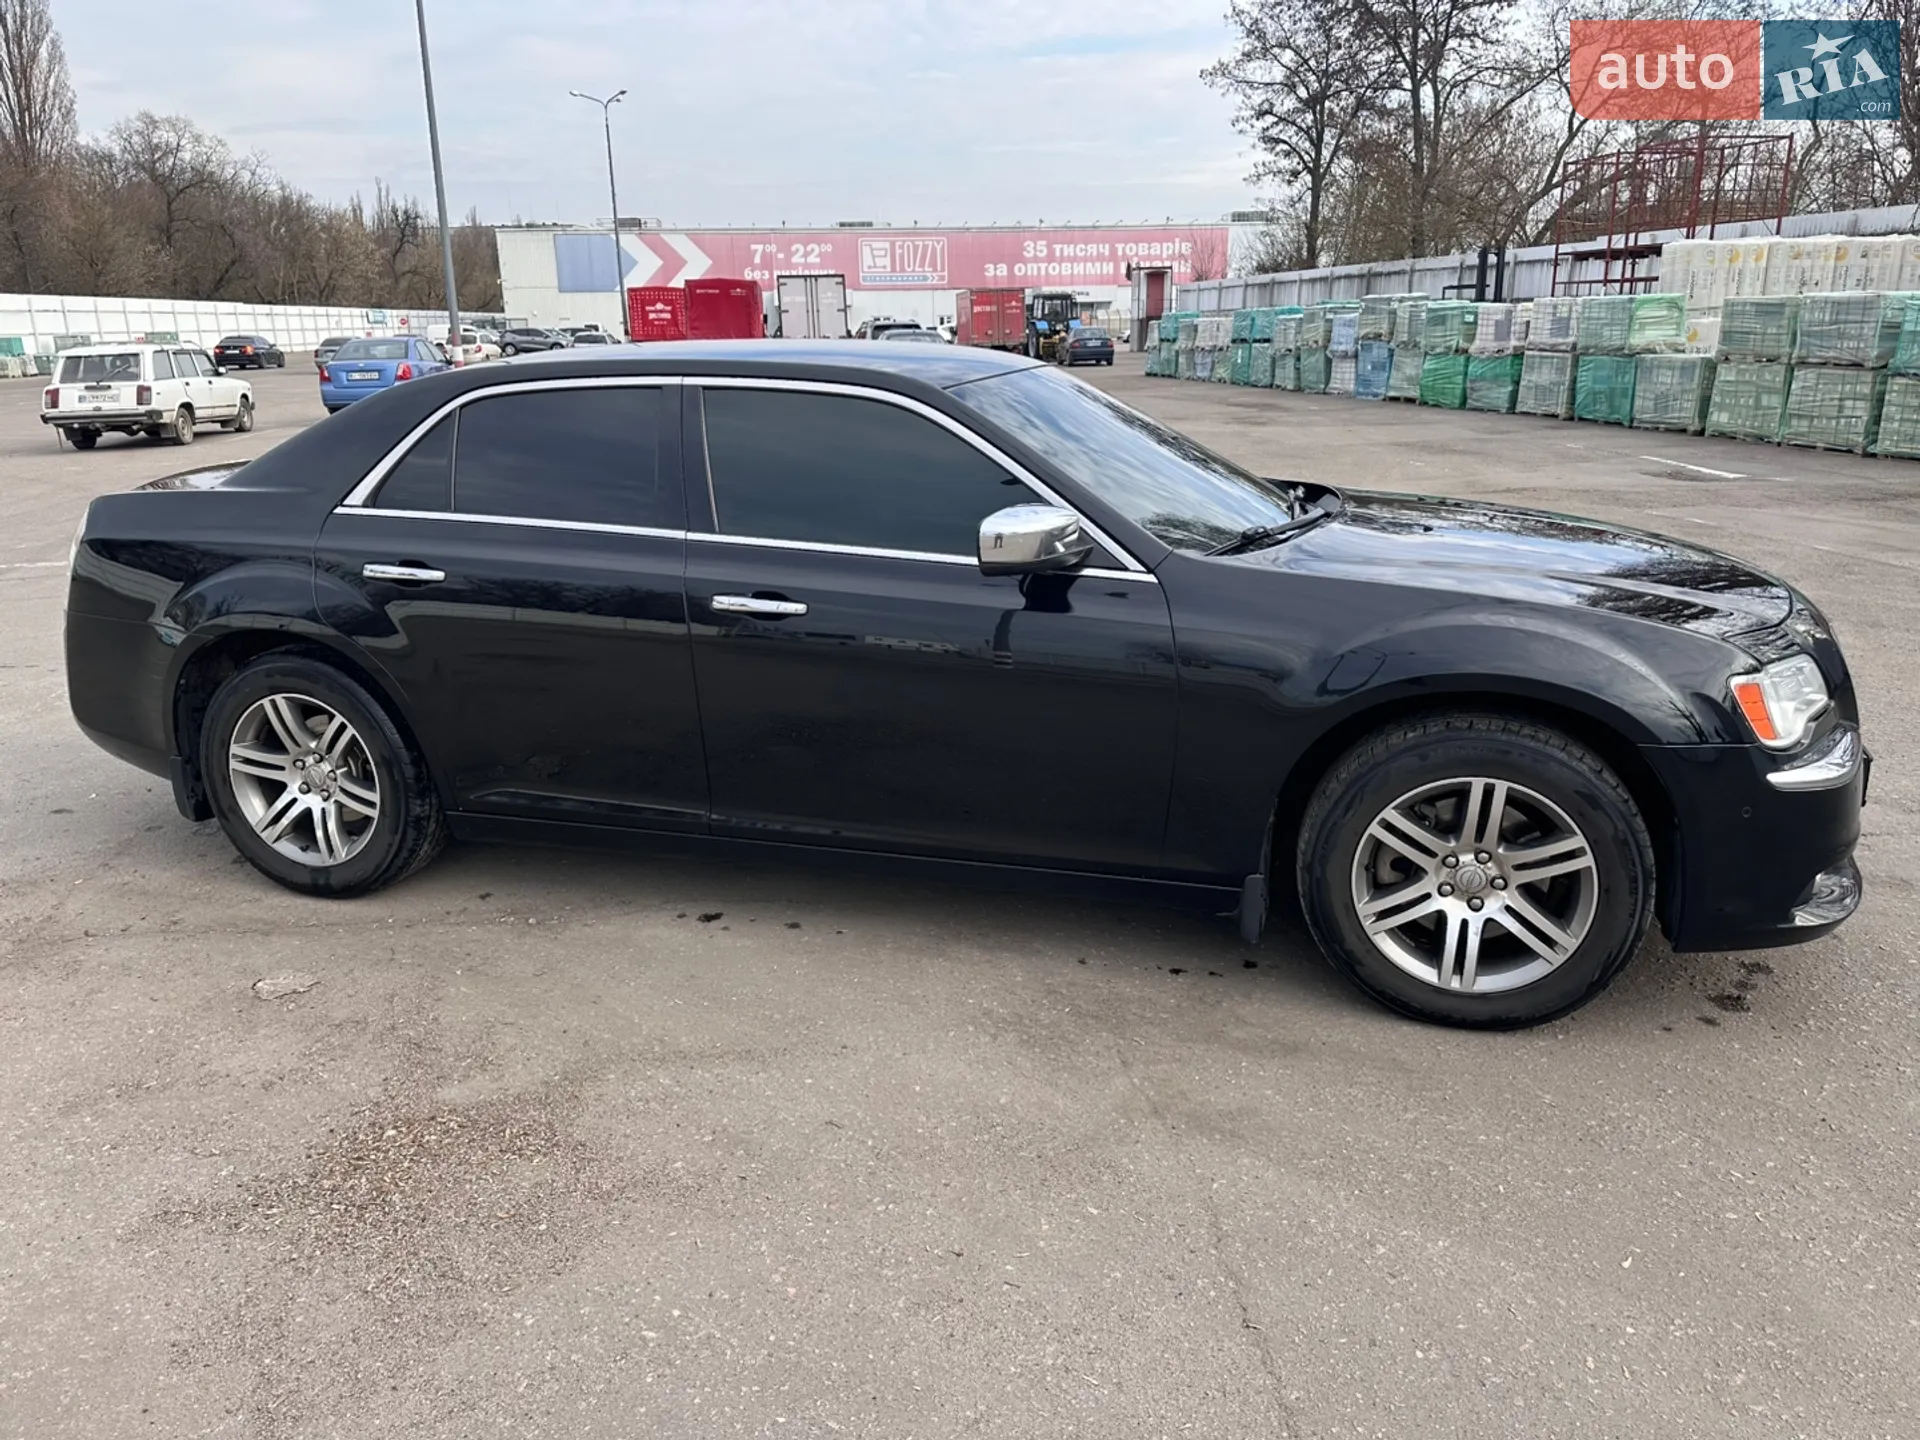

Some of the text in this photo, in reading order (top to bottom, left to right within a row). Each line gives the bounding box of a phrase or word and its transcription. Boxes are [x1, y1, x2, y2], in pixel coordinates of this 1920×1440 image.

[1023, 238, 1192, 258] 35 тисяч товарів
[895, 241, 944, 273] FOZZY
[744, 266, 769, 280] без
[984, 263, 1008, 277] за
[1014, 262, 1114, 276] оптовими
